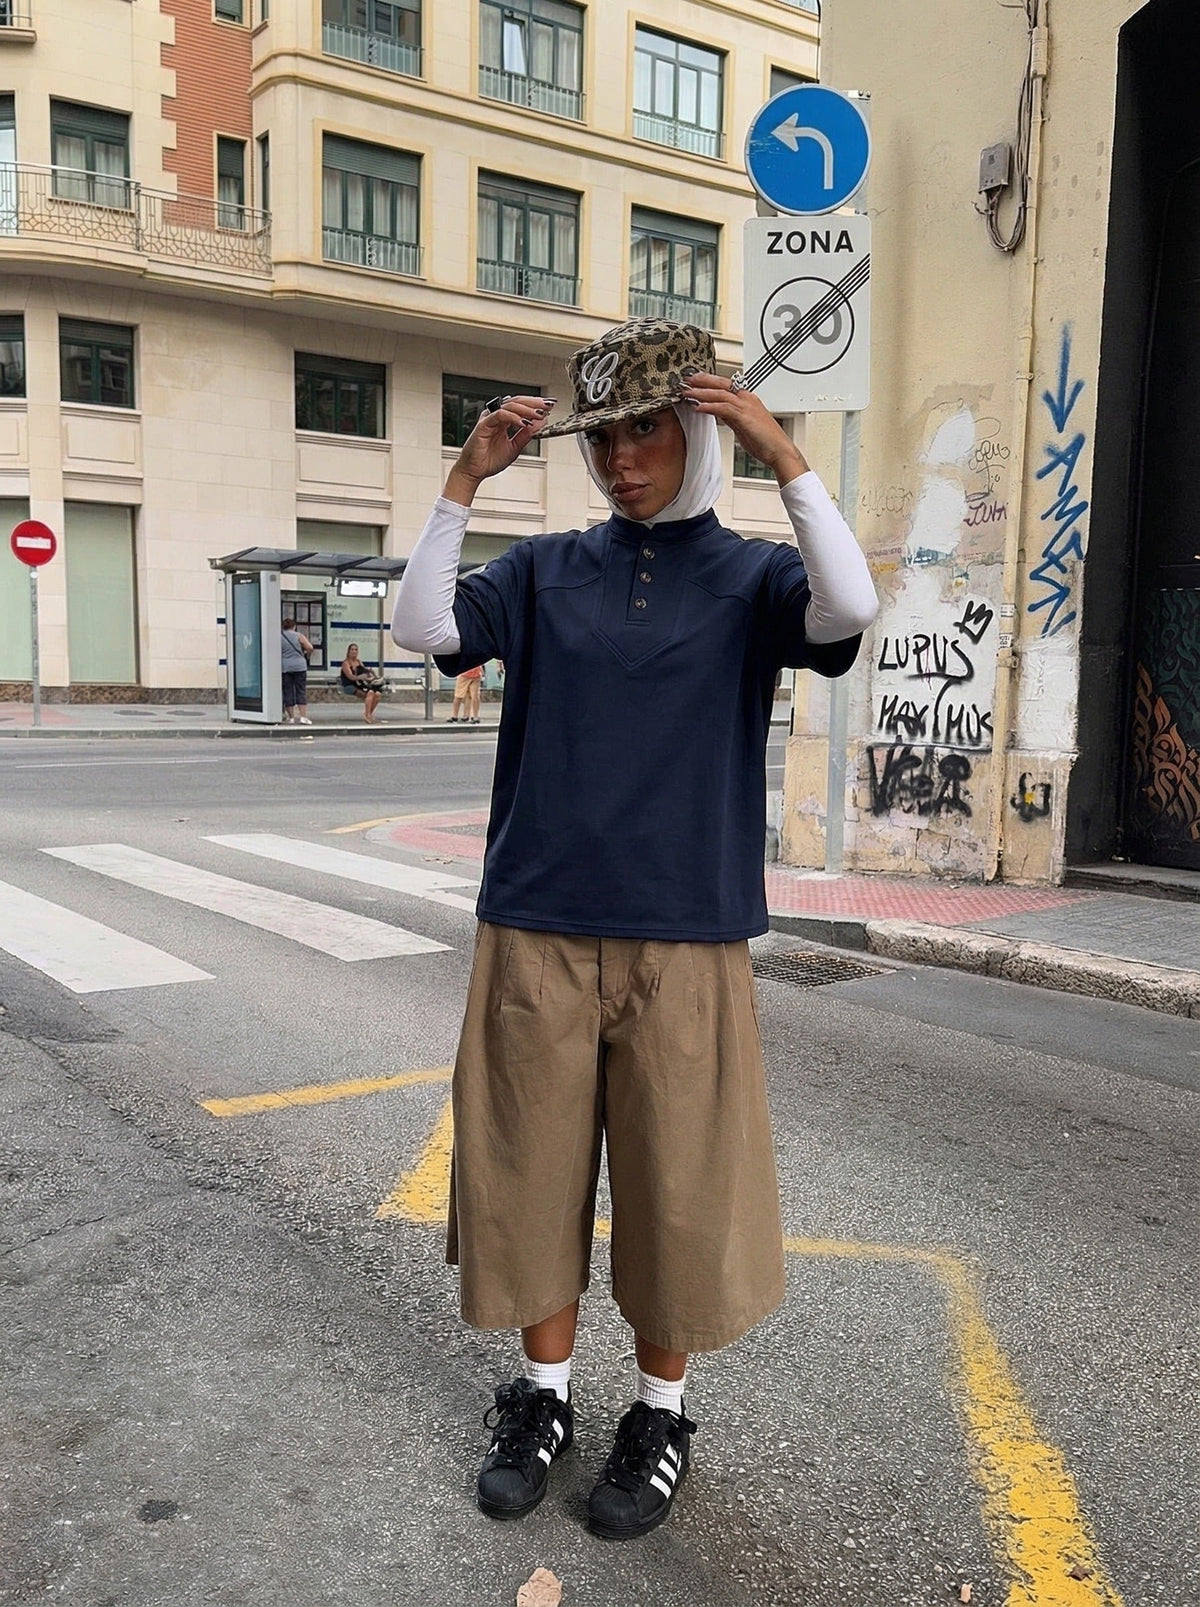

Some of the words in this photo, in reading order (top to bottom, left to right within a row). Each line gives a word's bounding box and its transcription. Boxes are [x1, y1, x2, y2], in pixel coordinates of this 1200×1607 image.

[766, 230, 854, 254] ZONA
[772, 303, 843, 345] 30
[878, 633, 974, 683] LUPUS
